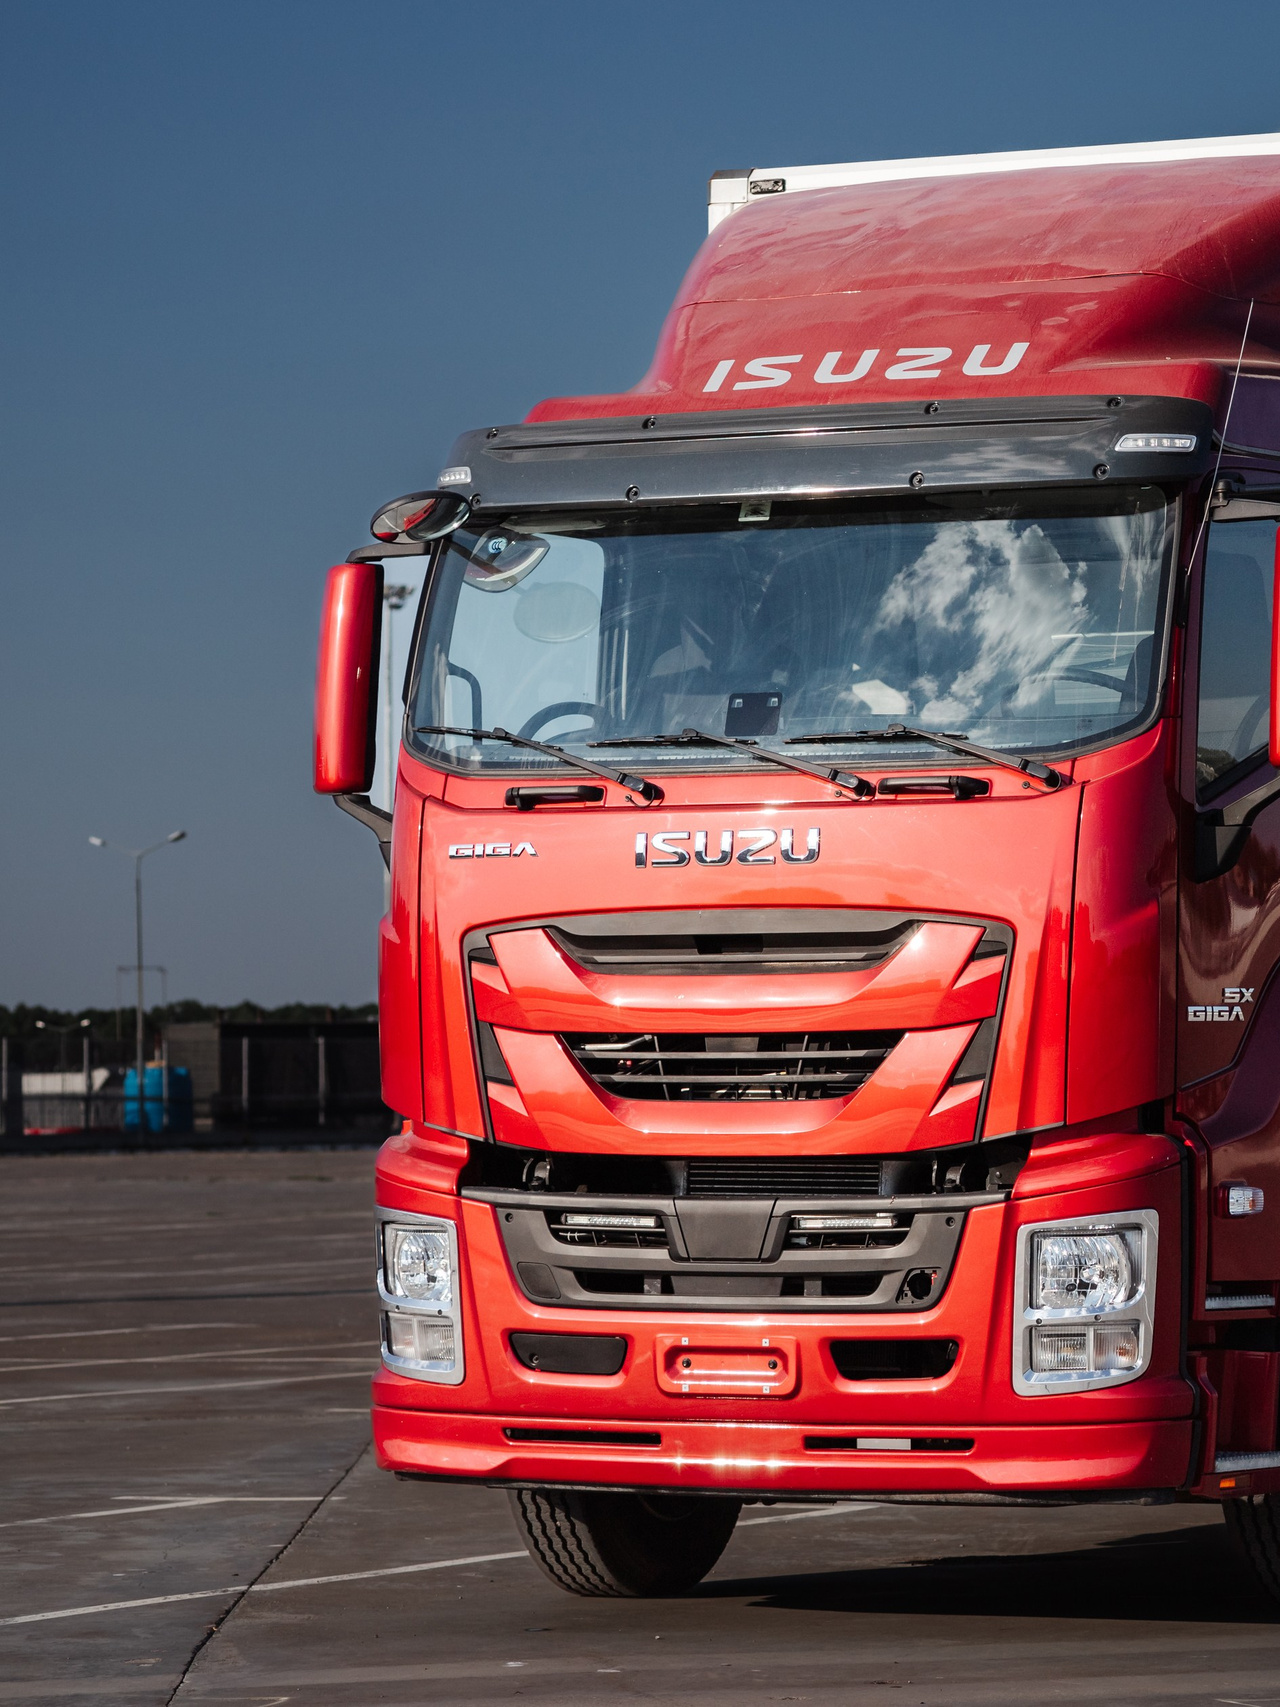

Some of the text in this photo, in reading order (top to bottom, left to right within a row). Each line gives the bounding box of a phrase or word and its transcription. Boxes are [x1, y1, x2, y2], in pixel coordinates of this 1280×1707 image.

[702, 342, 1030, 393] ISUZU
[448, 842, 539, 859] GIGA
[635, 828, 821, 868] ISUZU
[1187, 1006, 1245, 1022] GIGA
